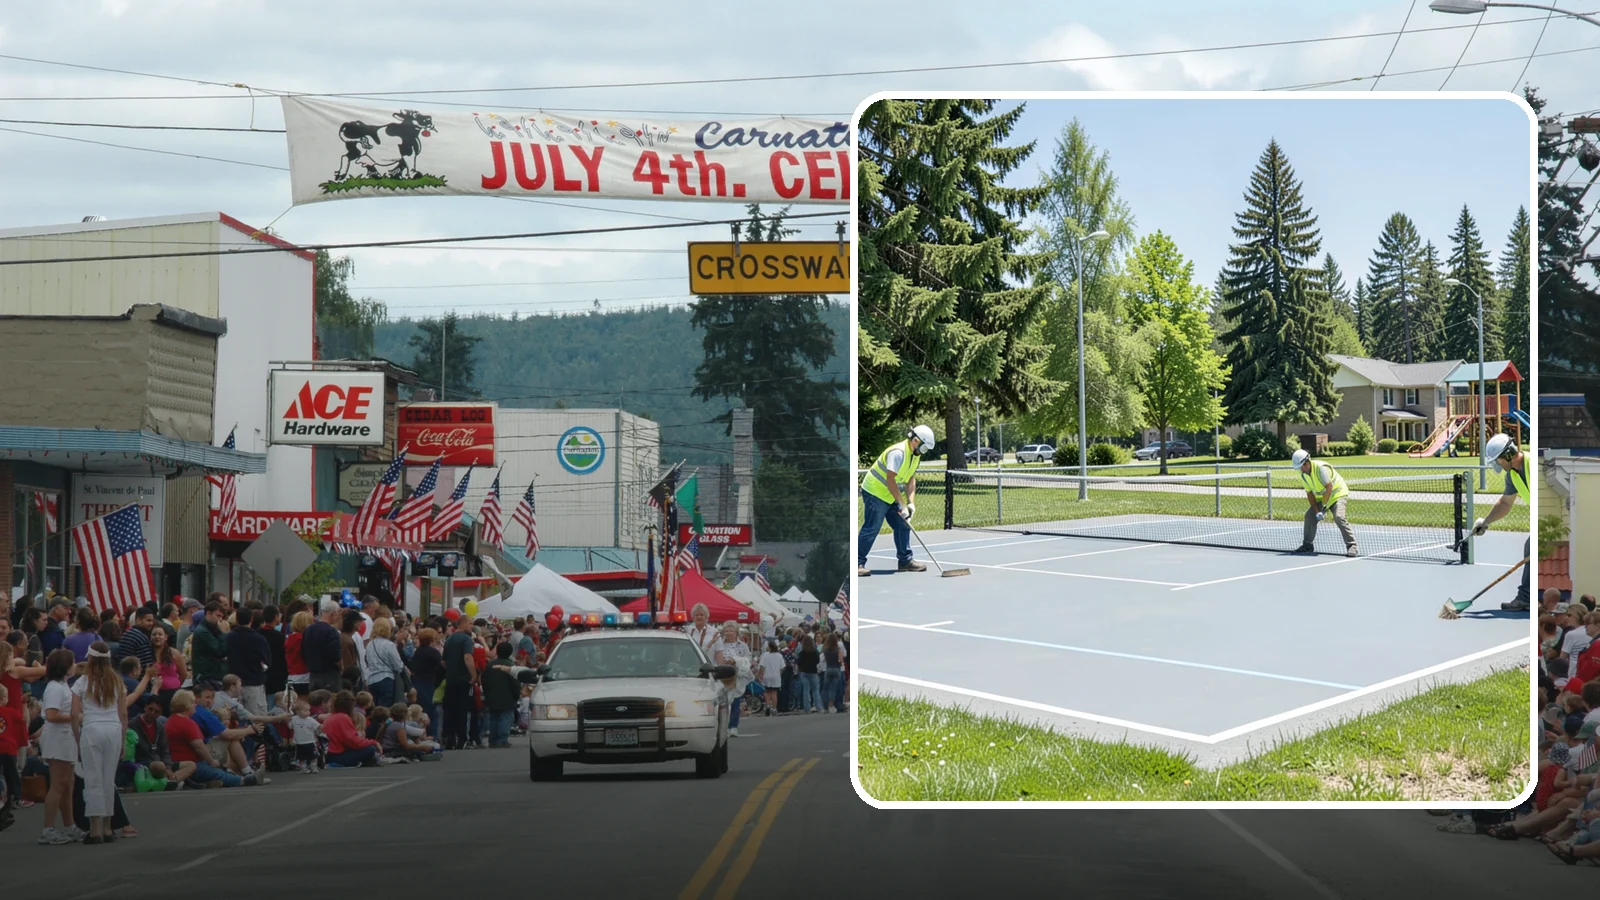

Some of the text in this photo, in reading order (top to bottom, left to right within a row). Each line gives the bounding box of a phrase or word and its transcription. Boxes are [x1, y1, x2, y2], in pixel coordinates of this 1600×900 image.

[695, 121, 850, 149] Carnat
[481, 141, 605, 192] JULY
[632, 150, 746, 197] 4th.
[697, 254, 850, 280] CROSSWA
[282, 380, 373, 420] ACE
[405, 409, 485, 422] CEDAR LOG
[283, 421, 370, 436] Hardware
[416, 428, 477, 446] Coca-Cola
[354, 466, 385, 481] Simpl
[83, 485, 155, 495] St. Vincent de Paul
[212, 516, 330, 535] HARDARE
[688, 527, 741, 535] CRNATION
[699, 535, 730, 543] GLASS
